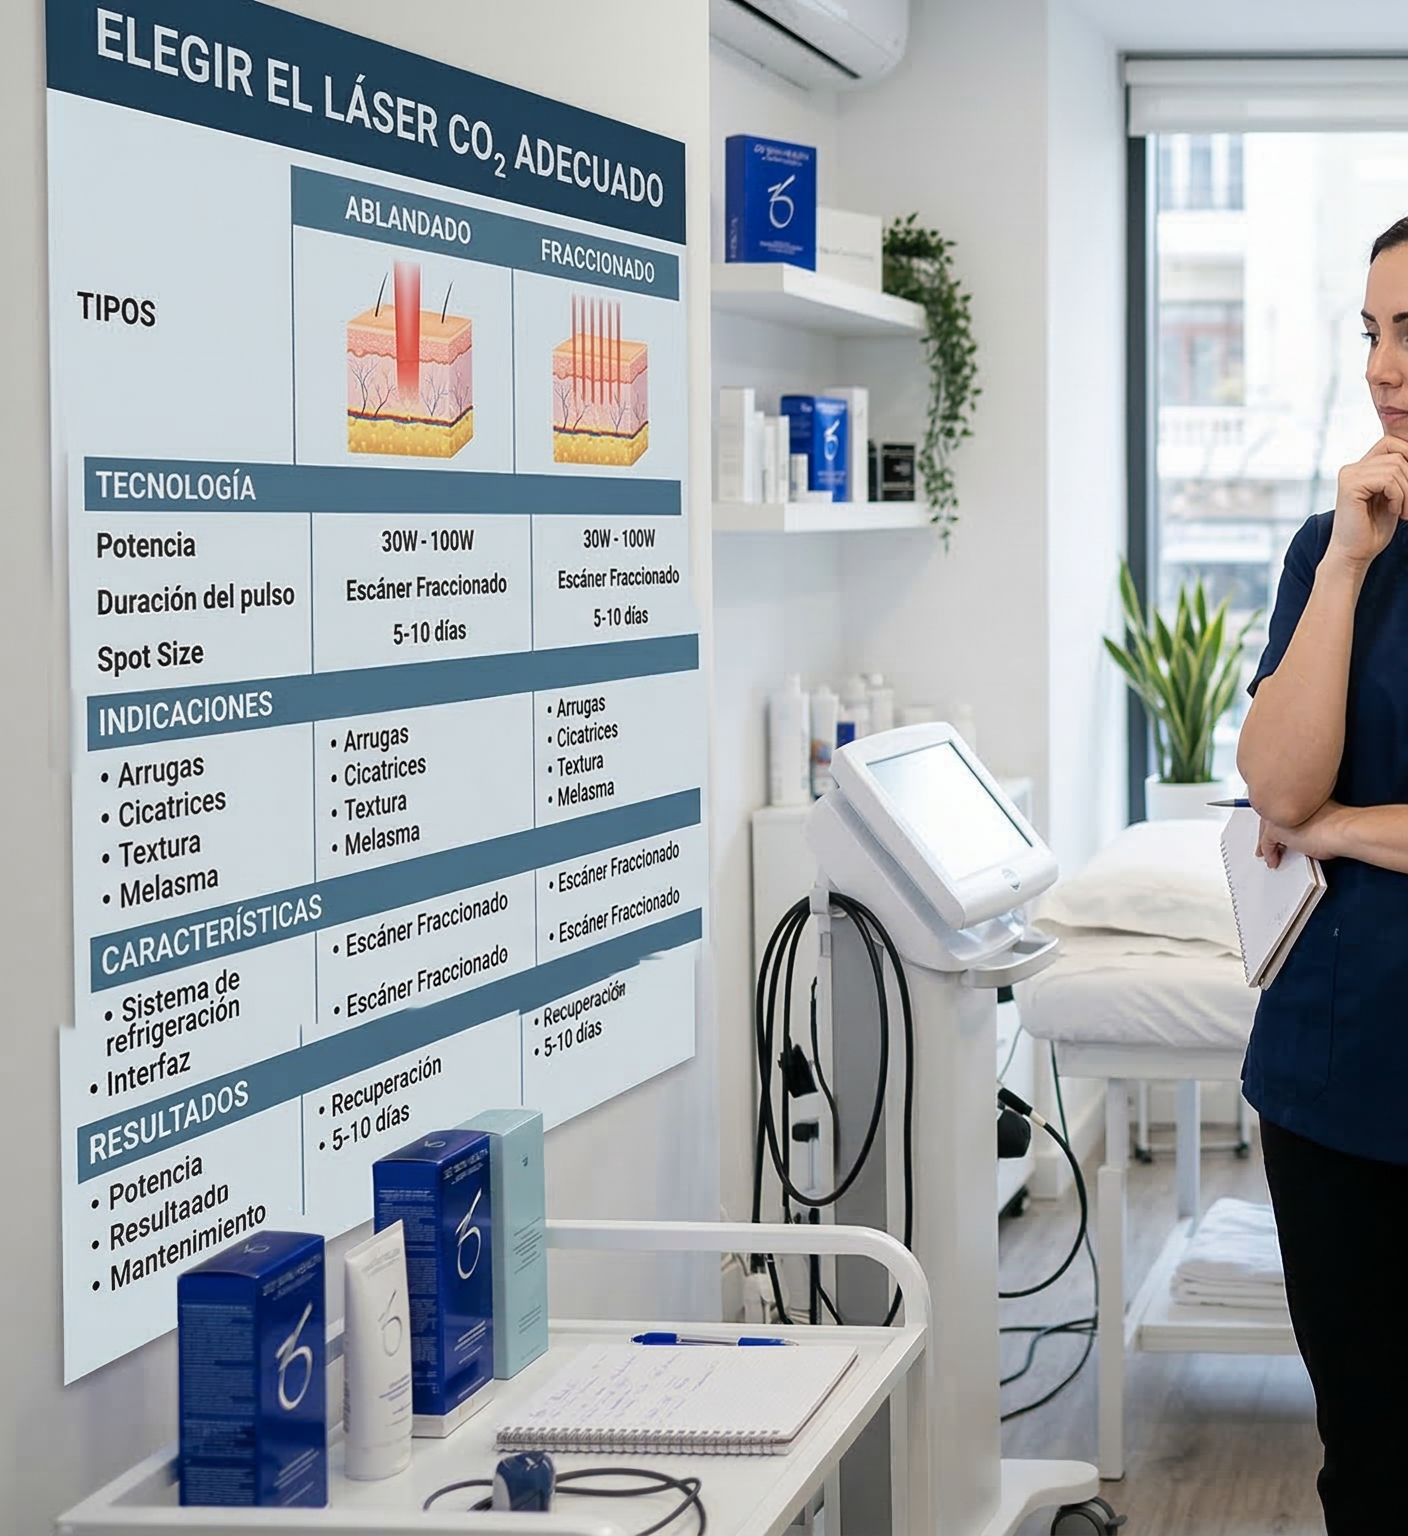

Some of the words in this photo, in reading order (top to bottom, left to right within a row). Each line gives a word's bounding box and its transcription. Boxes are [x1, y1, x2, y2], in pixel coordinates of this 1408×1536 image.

[97, 7, 254, 97] ELEGIR
[267, 57, 313, 114] EL
[324, 73, 439, 148] LÁSER
[514, 133, 664, 208] ADECUADO
[344, 195, 471, 245] ABLANDADO
[541, 238, 655, 283] FRACCIONADO
[76, 290, 156, 327] TIPOS
[95, 468, 257, 501] TECNOLOGÍA
[97, 530, 196, 559] Potencia
[381, 529, 418, 553] 30W
[430, 529, 475, 552] 100W
[583, 528, 611, 549] 30W
[621, 528, 656, 548] 100W
[346, 576, 413, 602] Escáner
[416, 572, 507, 598] Fraccionado
[558, 568, 608, 590] Escáner
[609, 564, 680, 587] Fraccionado
[97, 584, 197, 616] Duración
[203, 582, 235, 610] del
[240, 581, 295, 614] pulso
[593, 607, 622, 628] 5-10
[624, 605, 649, 626] días
[393, 621, 430, 646] 5-10
[434, 618, 467, 642] días
[97, 645, 151, 678] Spot
[156, 640, 204, 667] Size
[99, 690, 273, 736] INDICACIONES
[556, 696, 606, 719] Arrugas
[343, 727, 409, 753] Arrugas
[557, 721, 619, 748] Cicatrices
[117, 756, 205, 789] Arrugas
[344, 755, 427, 787] Cicatrices
[556, 754, 604, 777] Textura
[119, 790, 226, 828] Cicatrices
[344, 794, 407, 821] Textura
[557, 781, 615, 807] Melasma
[118, 834, 201, 868] Textura
[345, 824, 420, 857] Melasma
[558, 864, 608, 893] Escáner
[610, 840, 680, 877] Fraccionado
[120, 868, 219, 909] Melasma
[346, 921, 413, 958] Escáner
[417, 891, 508, 936] Fraccionado
[559, 912, 609, 943] Escáner
[611, 886, 680, 926] Fraccionado
[101, 893, 323, 976] CARACTERÍSTICAS
[122, 981, 210, 1023] Sistema
[215, 968, 240, 995] de
[347, 979, 413, 1018] Escáner
[417, 944, 508, 993] Fraccionado
[104, 996, 240, 1057] refrigeración
[544, 1028, 573, 1058] 5-10
[576, 1020, 603, 1044] días
[107, 1051, 191, 1097] Interfaz
[332, 1056, 442, 1119] Recuperación
[88, 1079, 250, 1165] RESULTADOS
[332, 1116, 371, 1151] 5-10
[375, 1104, 410, 1133] días
[109, 1155, 203, 1211] Potencia
[110, 1204, 267, 1292] Mantenimiento
